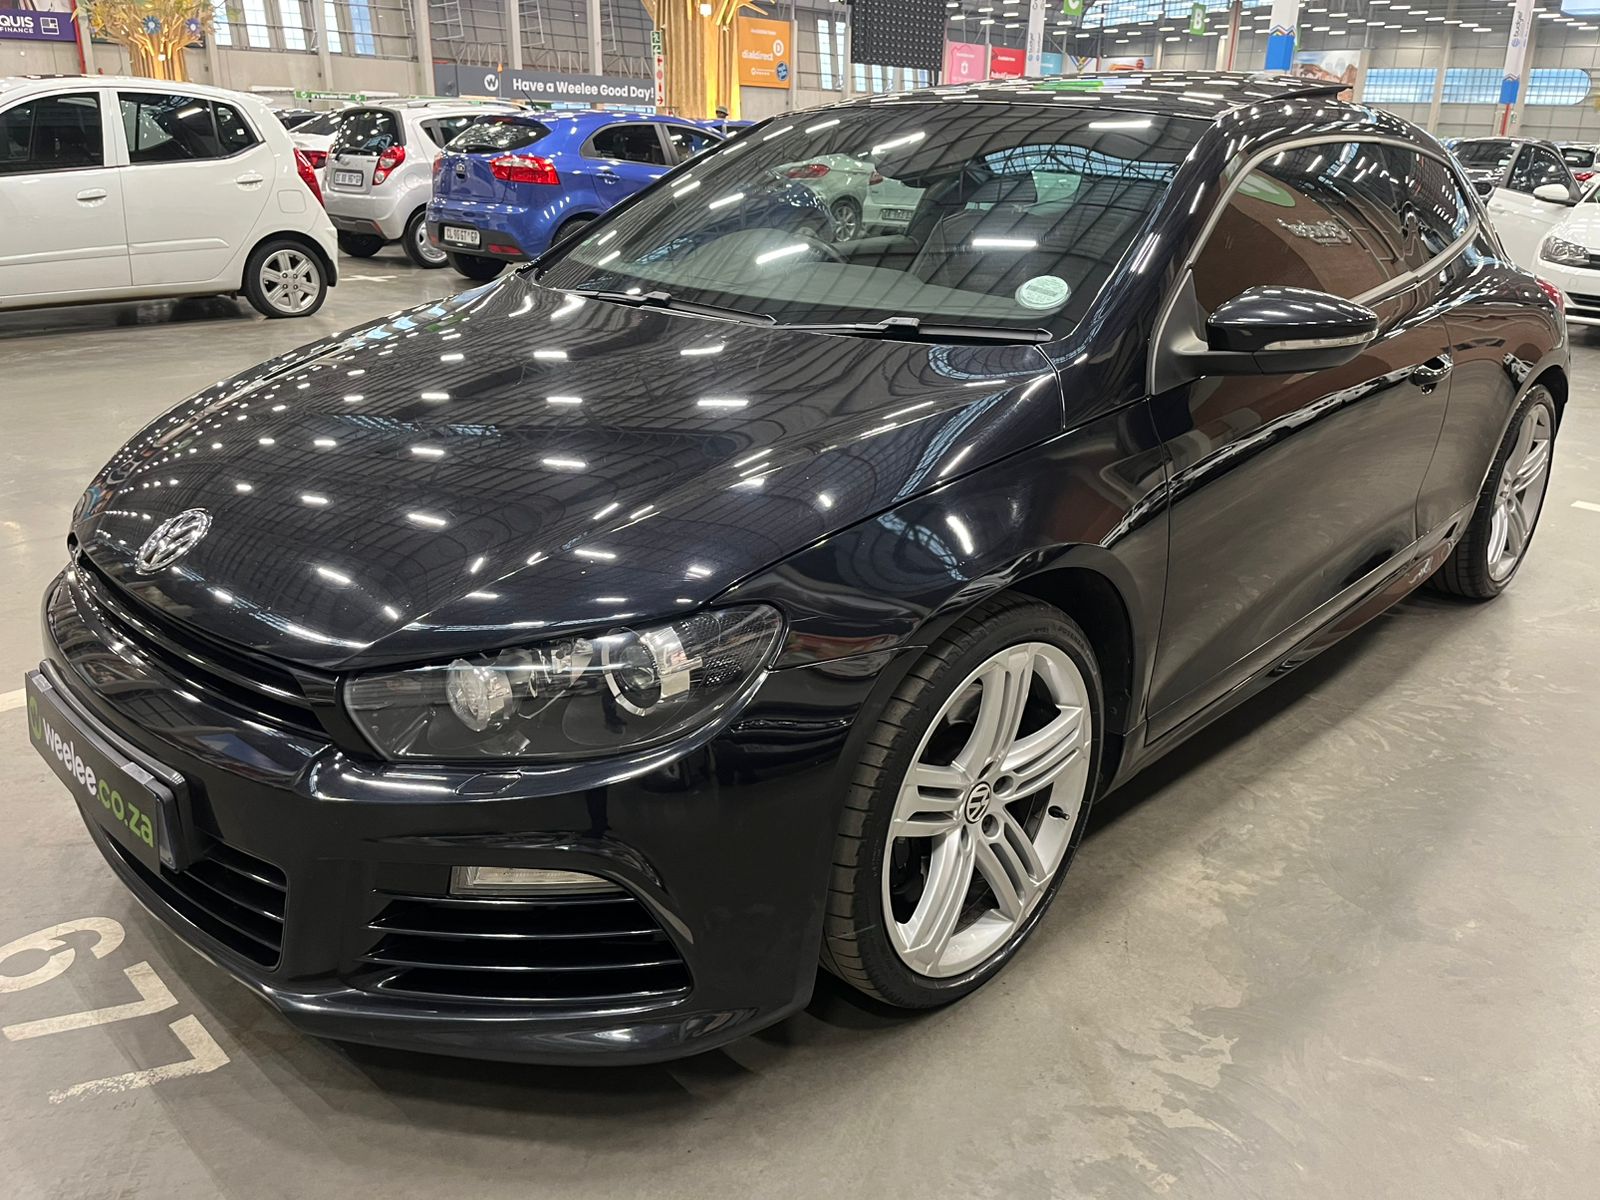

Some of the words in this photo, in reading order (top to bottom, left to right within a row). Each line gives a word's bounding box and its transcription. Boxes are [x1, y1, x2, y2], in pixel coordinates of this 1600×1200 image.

[0, 15, 34, 28] QUIS
[513, 78, 545, 92] Have
[546, 82, 555, 93] a
[556, 81, 598, 95] Weelee
[600, 84, 628, 97] Good
[629, 86, 654, 102] Day!
[43, 718, 154, 848] weelee.co.za
